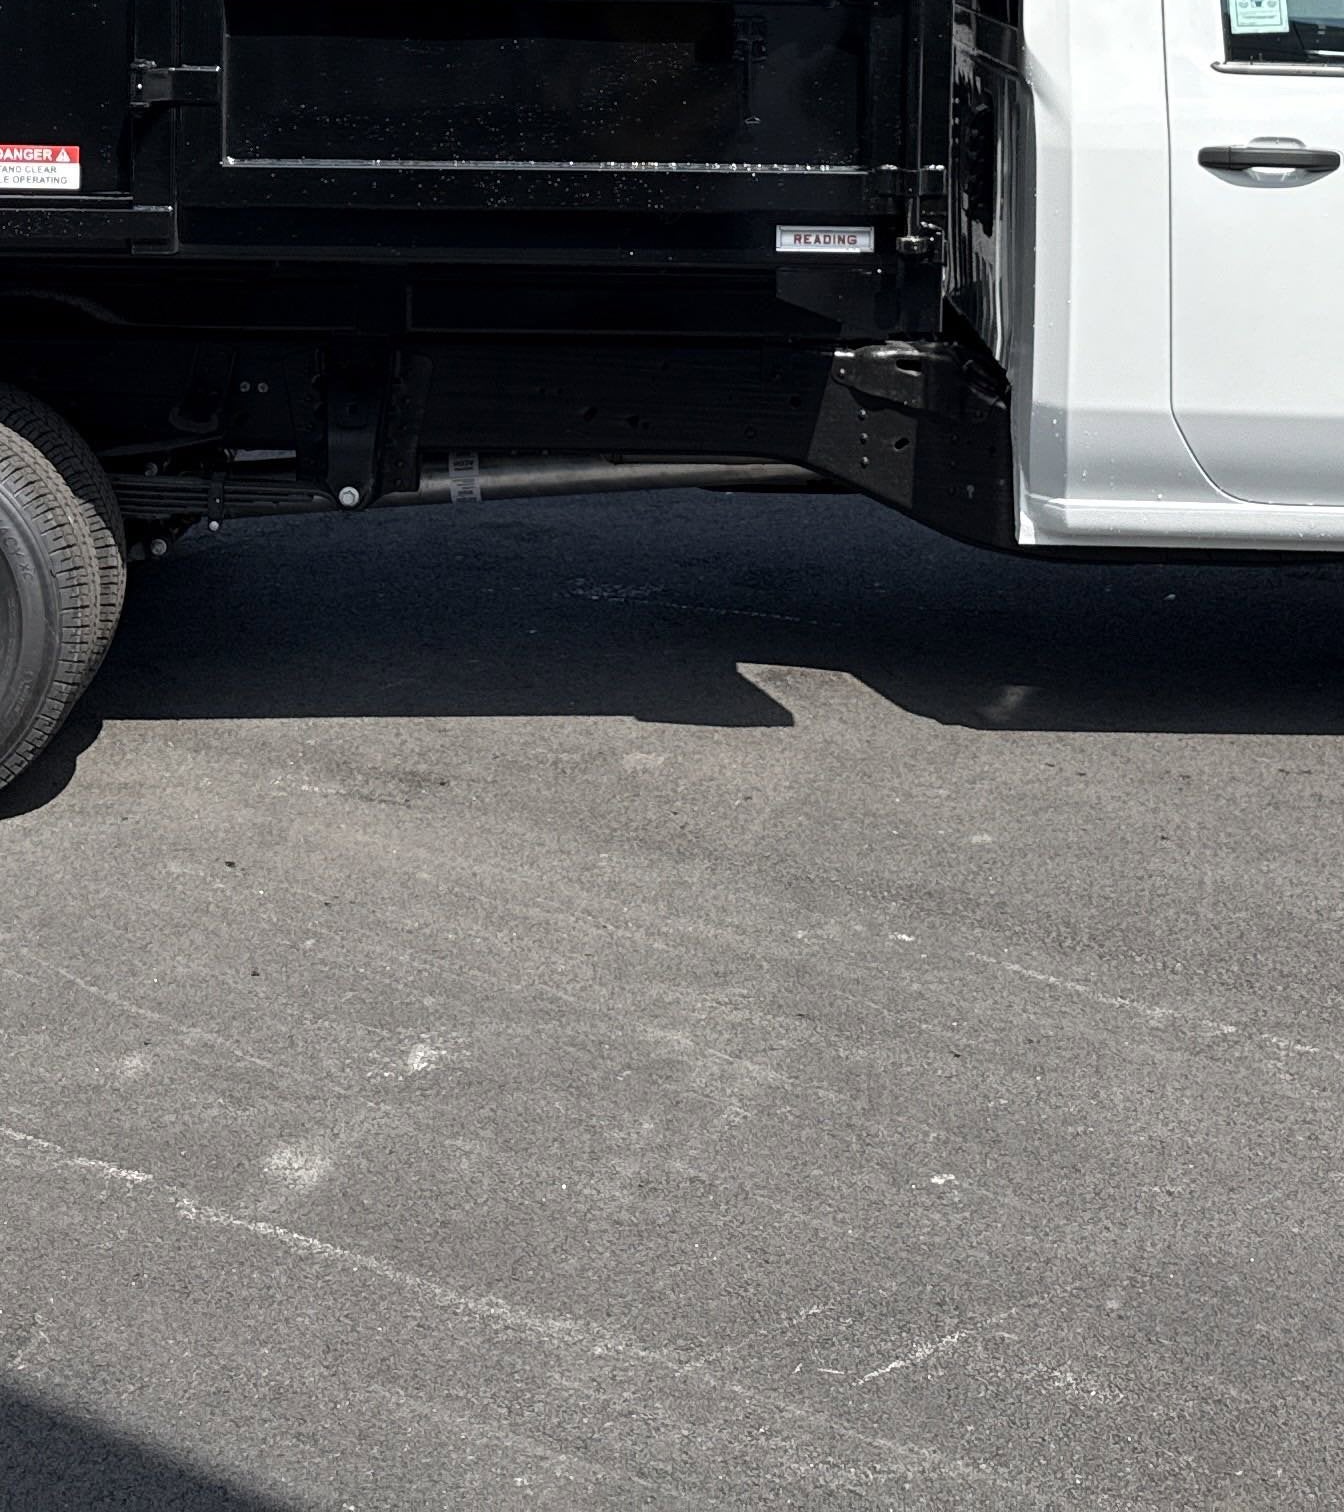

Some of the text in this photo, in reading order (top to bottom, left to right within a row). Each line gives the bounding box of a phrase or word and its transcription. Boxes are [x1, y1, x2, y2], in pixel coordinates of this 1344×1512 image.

[25, 165, 57, 174] CLEAR
[12, 176, 68, 185] OPERATING
[793, 233, 858, 245] READING
